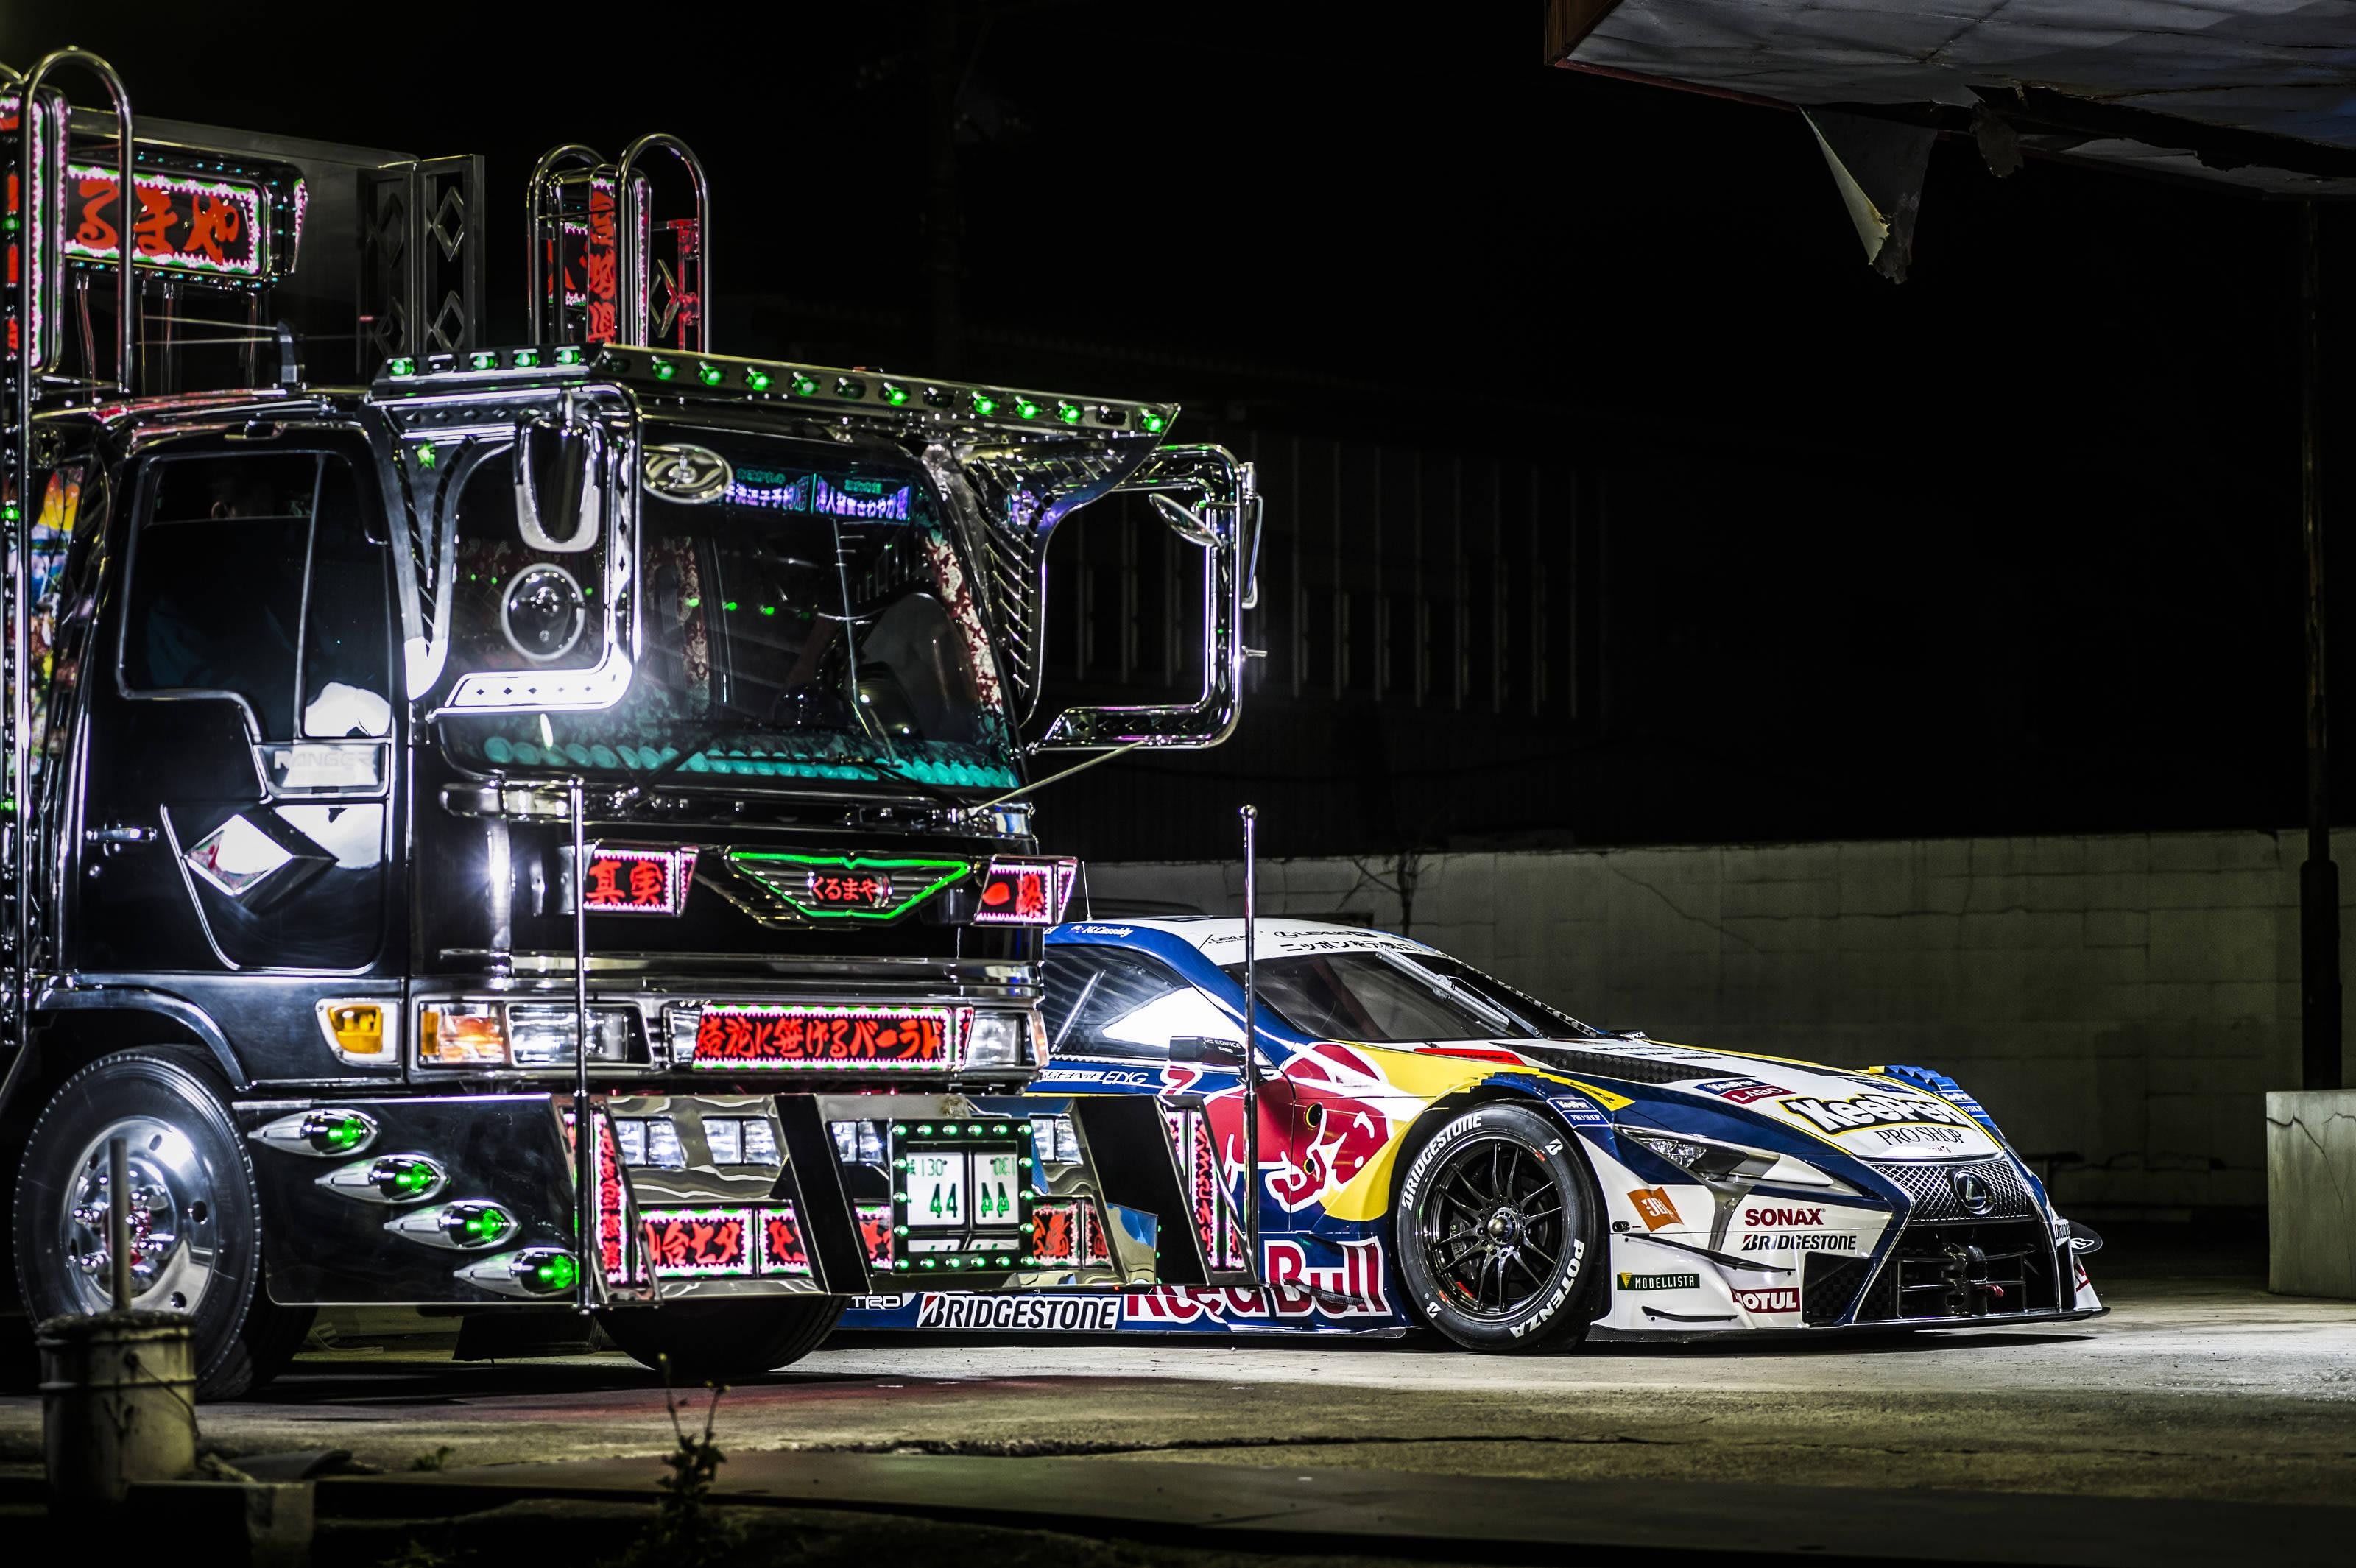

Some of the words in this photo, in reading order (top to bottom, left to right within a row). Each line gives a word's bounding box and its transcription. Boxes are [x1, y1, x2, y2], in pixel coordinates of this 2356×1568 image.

[812, 876, 879, 903] くるまや
[1214, 1039, 1241, 1048] EDIFICE
[1732, 1087, 1784, 1102] LABO
[1783, 1091, 1968, 1132] KeePer
[1876, 1128, 1918, 1146] PRO
[1916, 1126, 1967, 1143] SHOP
[1402, 1112, 1483, 1211] BRIDGESTONE
[930, 1182, 958, 1218] 44
[1745, 1208, 1824, 1226] SONAX
[1742, 1234, 1857, 1251] BRIDGESTONE
[1267, 1240, 1388, 1314] Bull
[1509, 1238, 1585, 1338] POTENZA
[1634, 1276, 1694, 1289] MODELLISTA
[851, 1296, 902, 1310] TRD
[920, 1294, 1120, 1329] BRIDGESTONE
